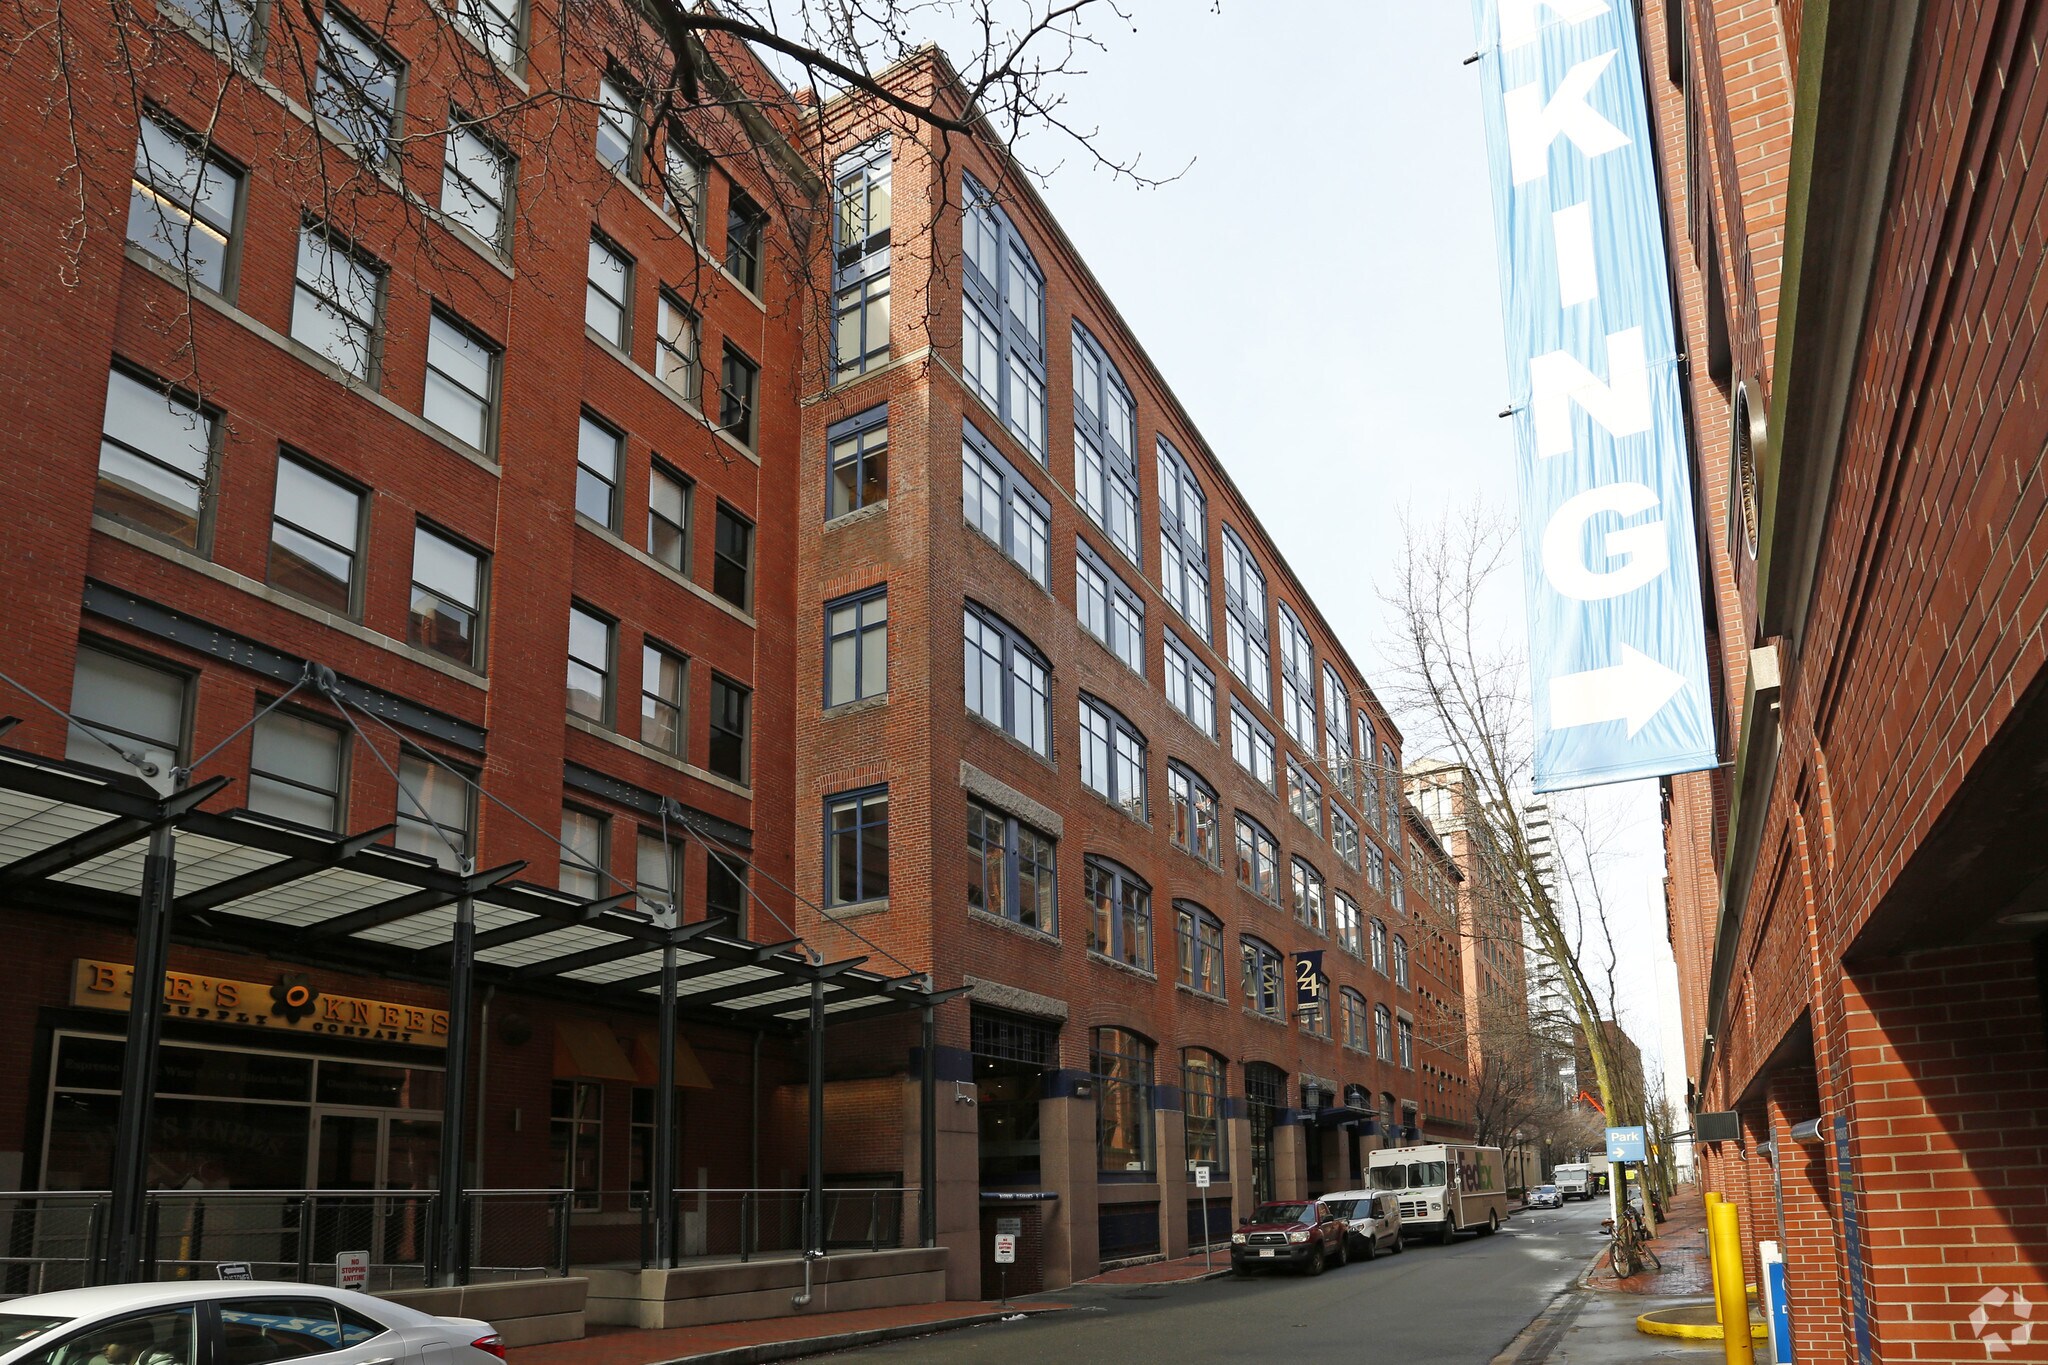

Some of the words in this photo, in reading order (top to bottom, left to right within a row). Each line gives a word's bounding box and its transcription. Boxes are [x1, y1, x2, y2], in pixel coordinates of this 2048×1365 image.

[1296, 960, 1320, 997] 24
[87, 964, 242, 1009] BE'S
[323, 997, 448, 1035] KNEES
[161, 1002, 268, 1026] SUPPLY
[313, 1022, 412, 1042] COMPANY
[1611, 1132, 1639, 1142] Park
[1458, 1151, 1494, 1193] FedEx
[341, 1266, 366, 1274] STOPPING
[343, 1274, 365, 1282] ANYTIME
